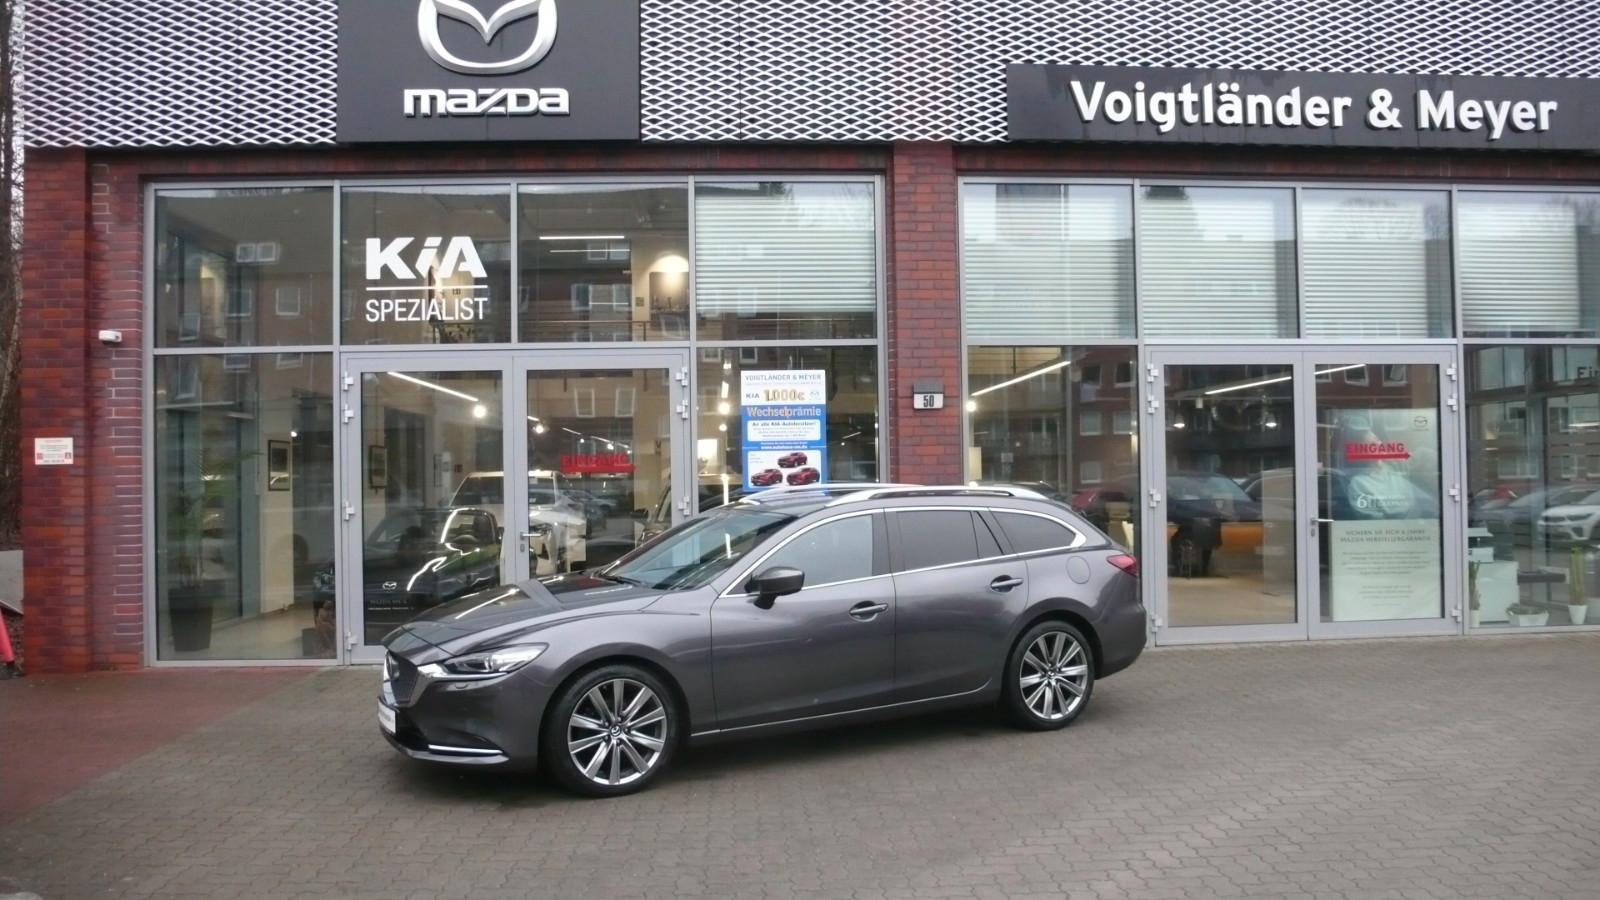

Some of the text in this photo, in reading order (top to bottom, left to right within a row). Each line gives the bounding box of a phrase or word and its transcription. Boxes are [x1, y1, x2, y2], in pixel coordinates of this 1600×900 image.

[1070, 79, 1558, 140] Voigtländer & Meyer
[365, 297, 488, 323] SPEZIALIST
[923, 394, 935, 408] 50
[746, 405, 822, 418] Wechselprämie
[1347, 442, 1405, 453] EINGANG
